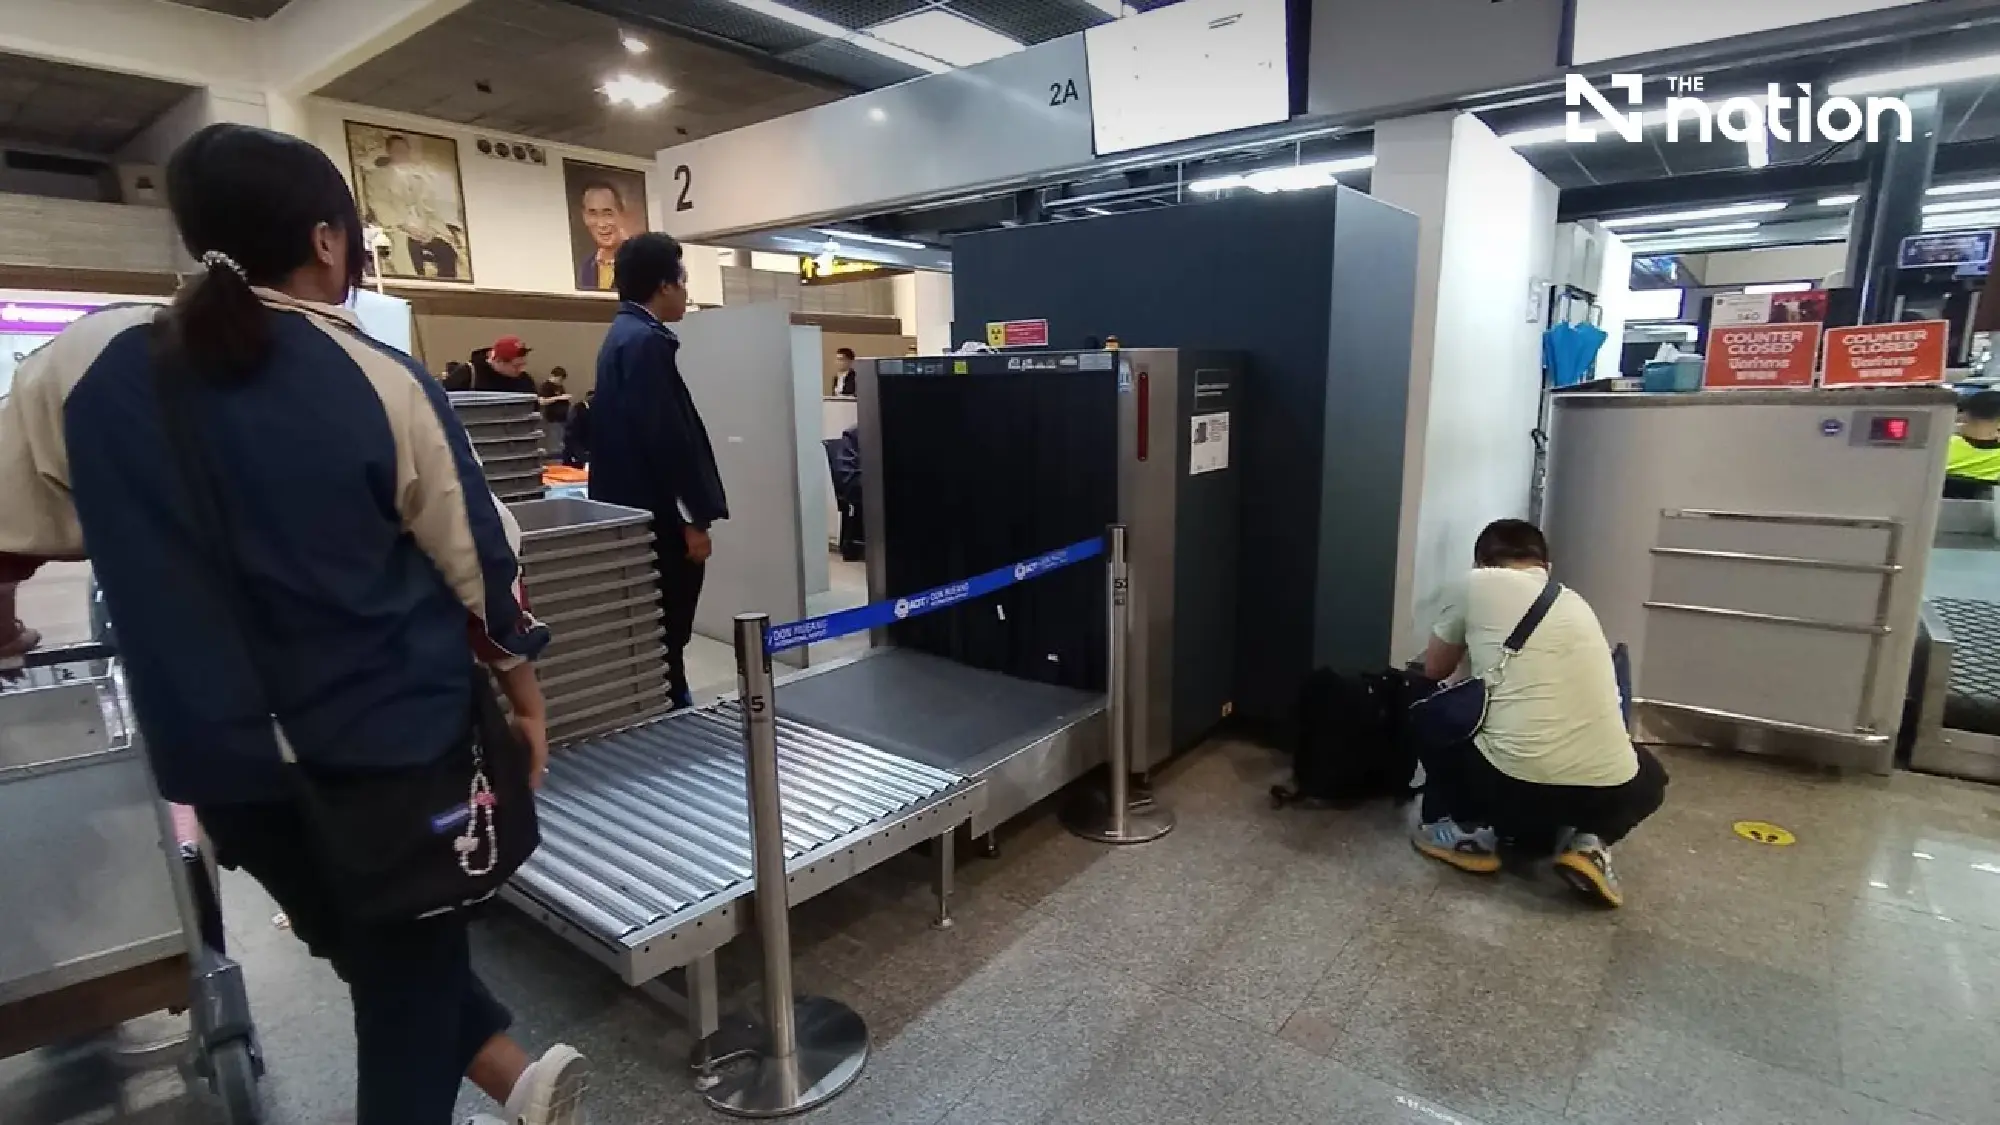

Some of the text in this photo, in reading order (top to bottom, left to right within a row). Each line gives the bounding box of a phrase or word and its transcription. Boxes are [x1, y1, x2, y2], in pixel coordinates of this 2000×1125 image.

[1049, 77, 1079, 107] 2A
[674, 164, 693, 212] 2
[1722, 330, 1804, 344] COUNTER
[1842, 330, 1928, 345] COUNTER
[1728, 342, 1794, 355] CLOSED
[1848, 341, 1919, 355] CLOSED
